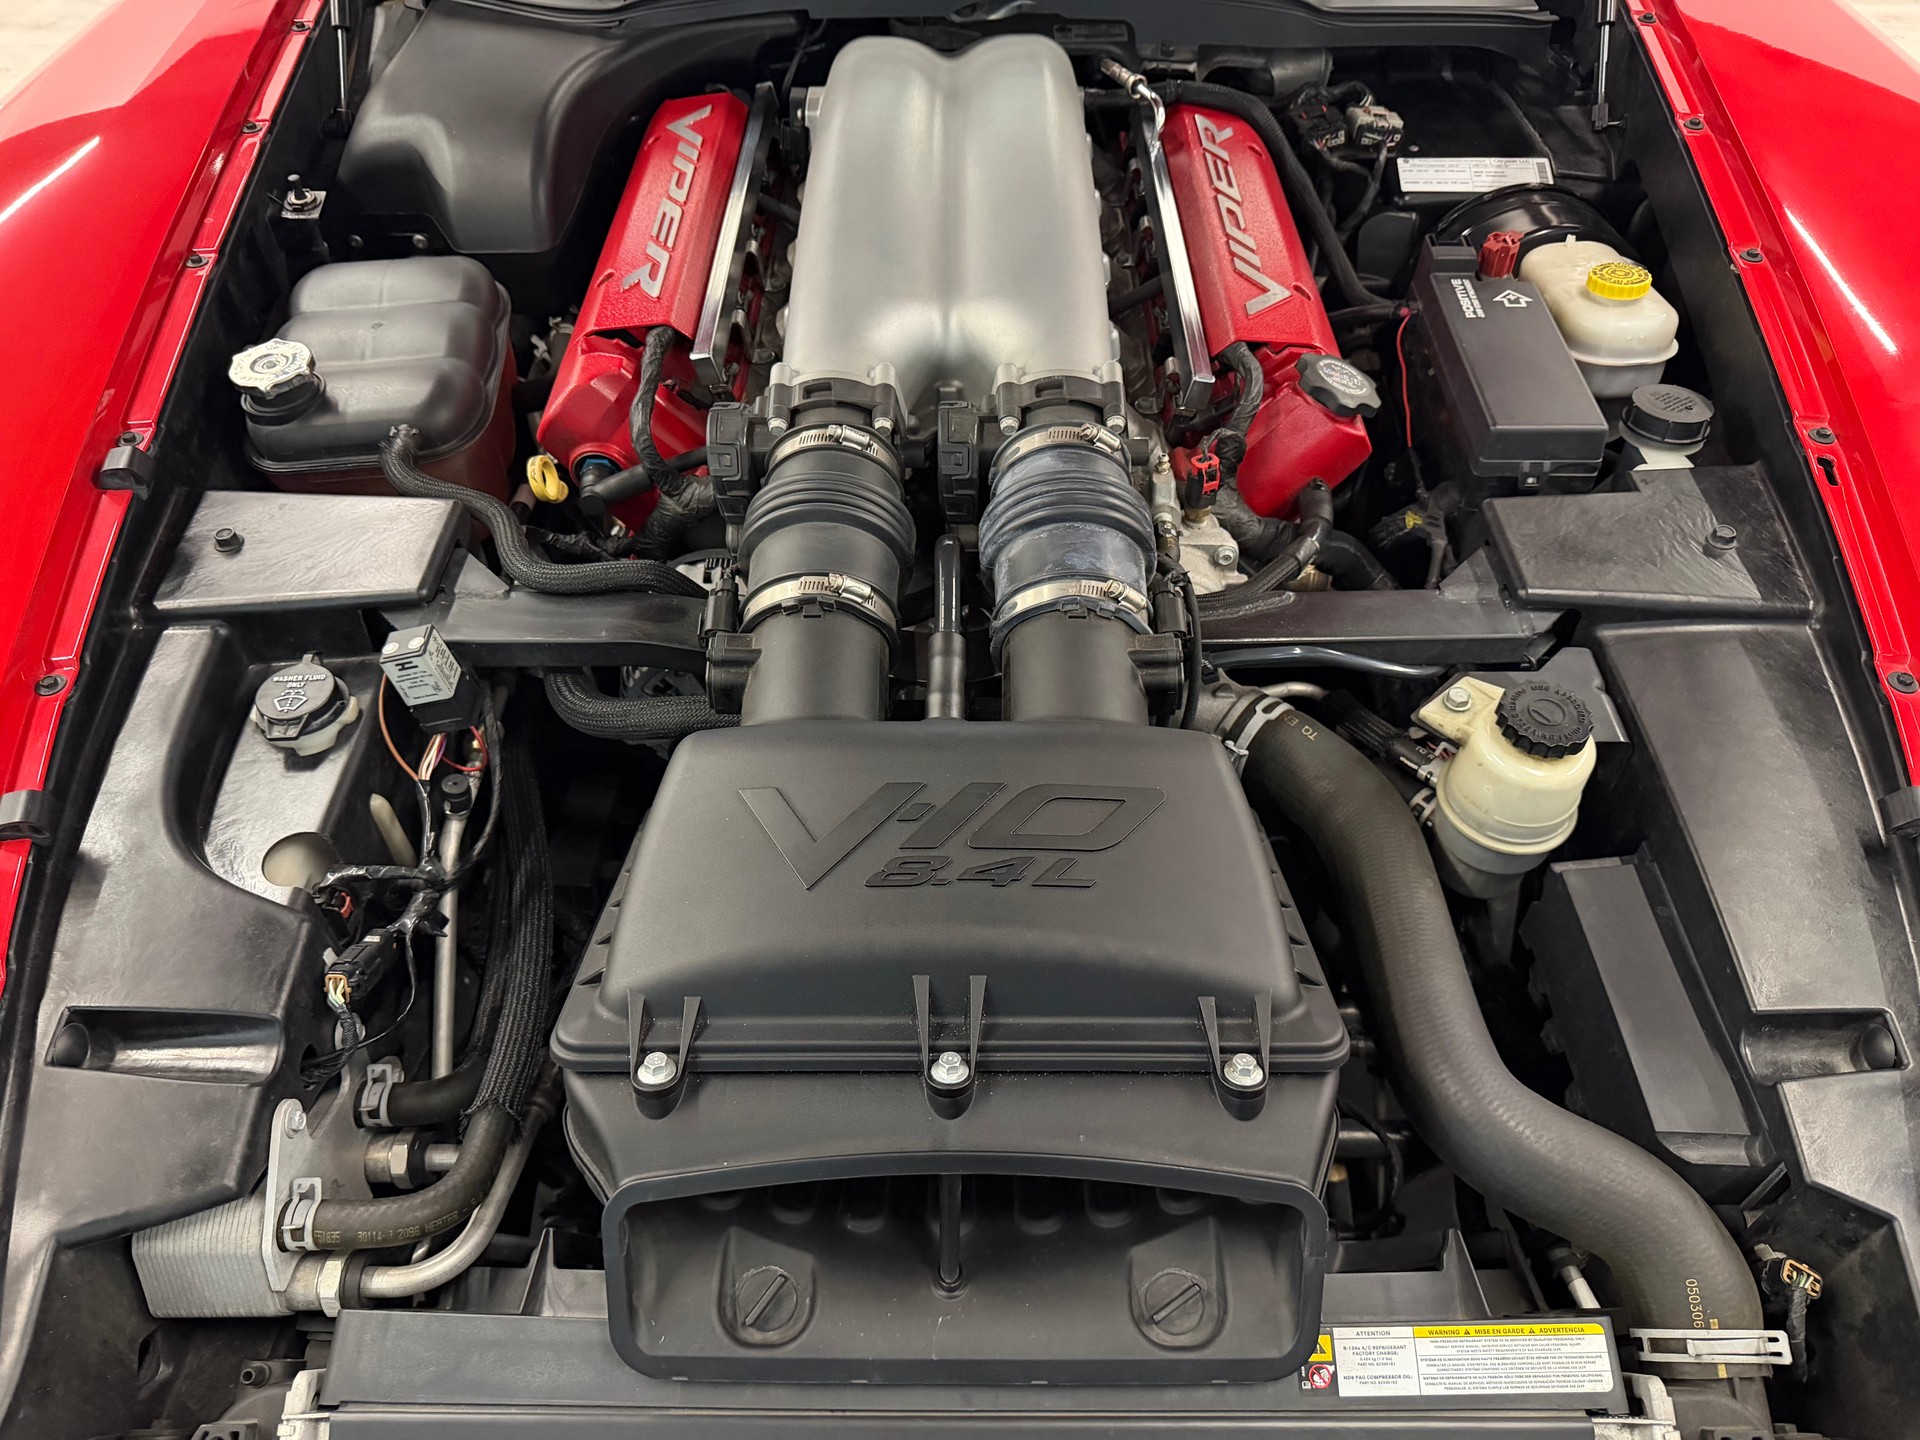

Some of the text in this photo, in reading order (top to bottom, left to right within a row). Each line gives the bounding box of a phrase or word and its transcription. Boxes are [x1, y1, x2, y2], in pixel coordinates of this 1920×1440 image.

[621, 104, 714, 299] VIPER
[1192, 112, 1292, 318] VIPER
[1450, 278, 1476, 318] POSITIVE
[1301, 725, 1318, 741] TO
[864, 854, 1097, 890] 8.4L
[1685, 1278, 1704, 1328] 050306
